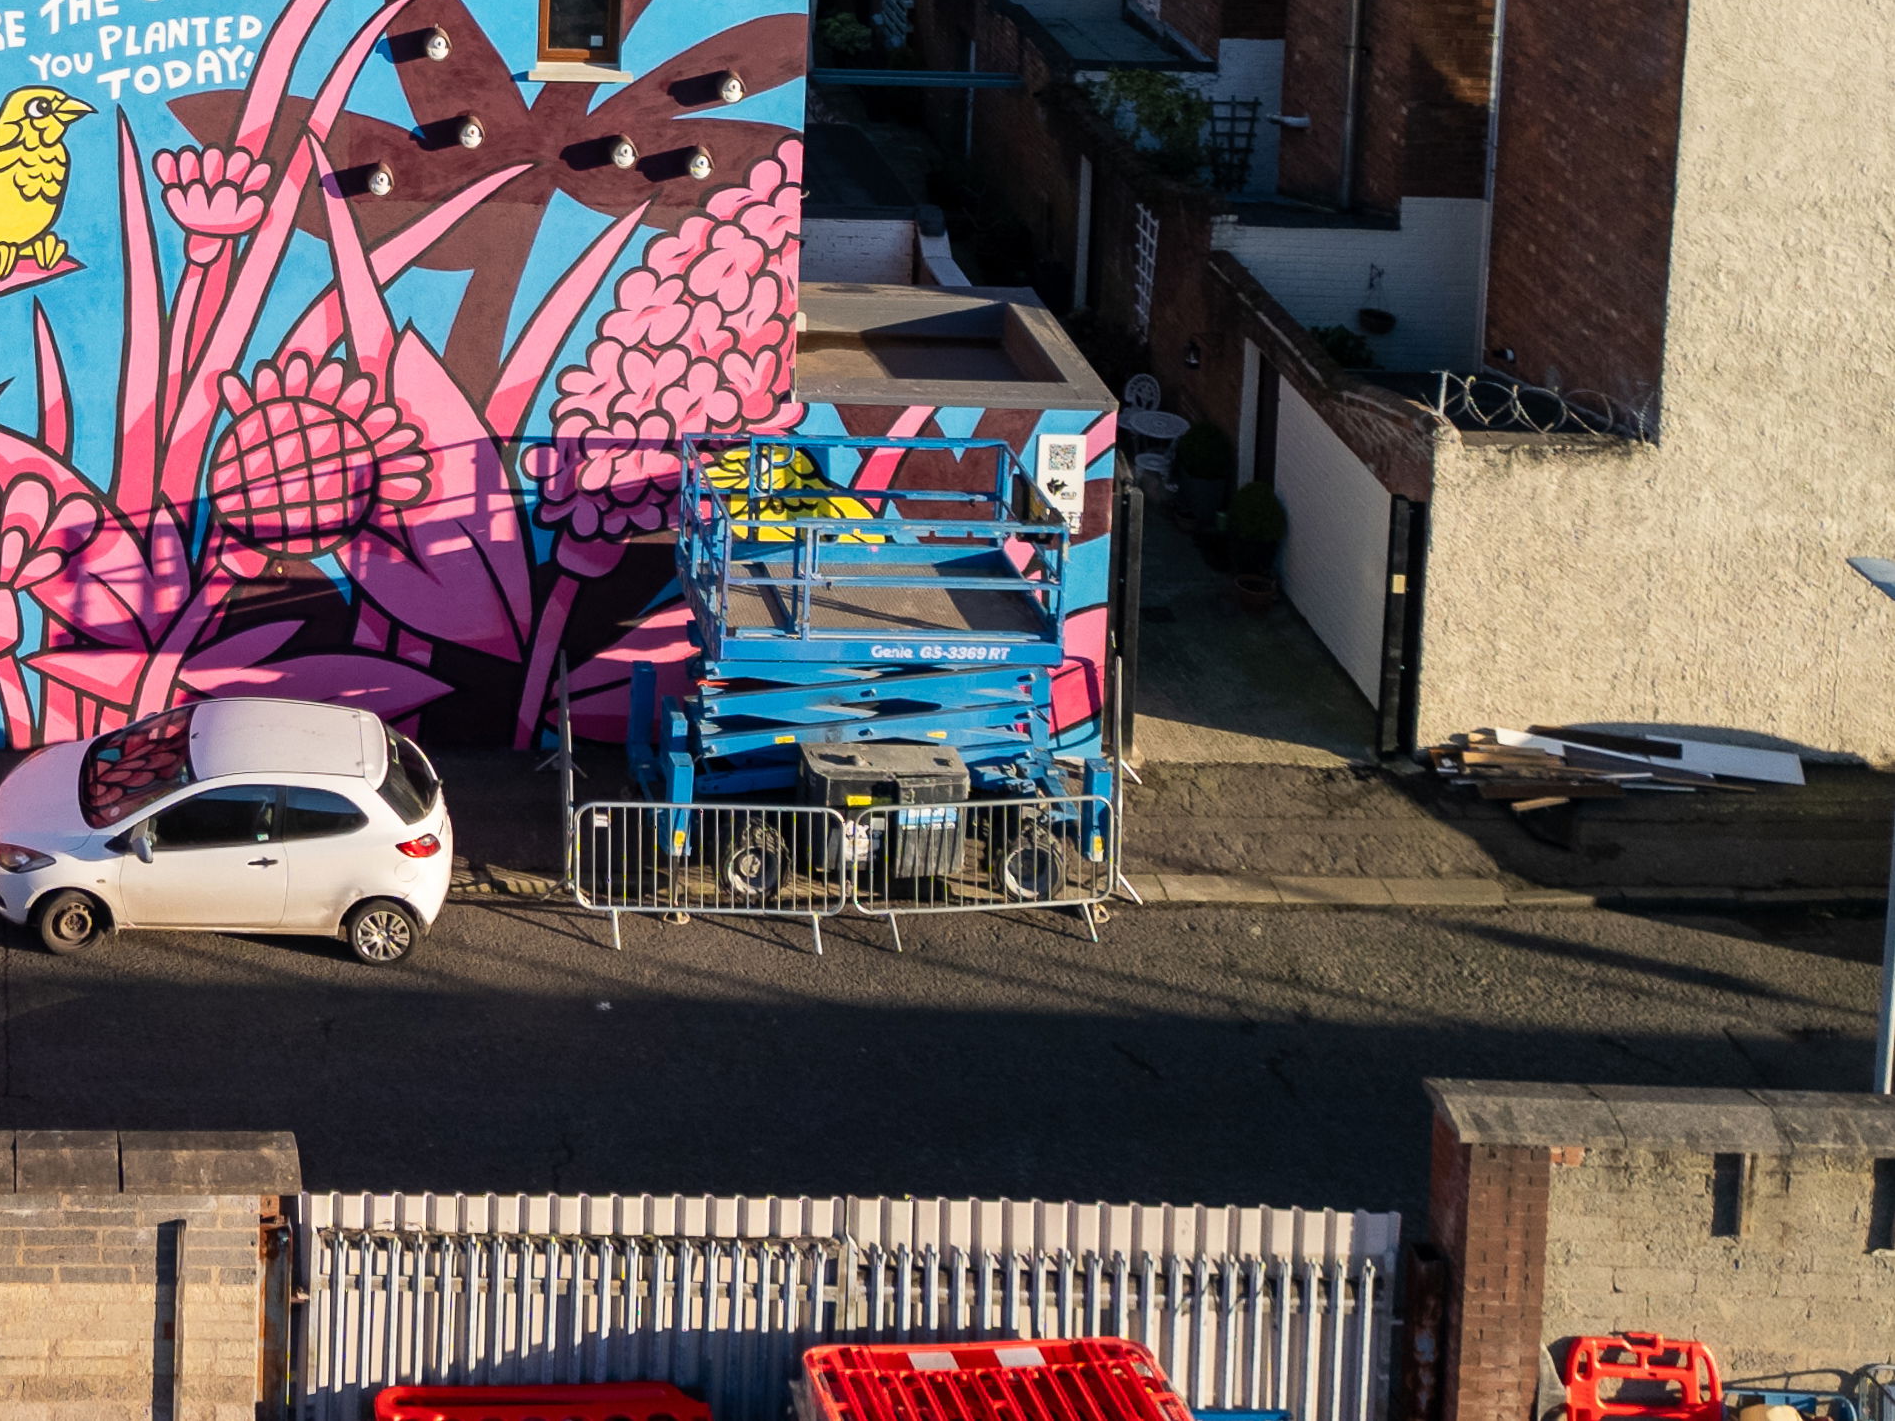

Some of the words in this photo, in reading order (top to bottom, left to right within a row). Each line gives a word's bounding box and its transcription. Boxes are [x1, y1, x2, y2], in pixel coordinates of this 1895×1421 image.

[28, 52, 94, 82] YOU
[99, 14, 263, 61] PLANTED
[97, 45, 255, 100] TODAY!
[871, 645, 913, 659] Genie
[920, 645, 987, 660] GS-3369
[988, 647, 1010, 660] RT
